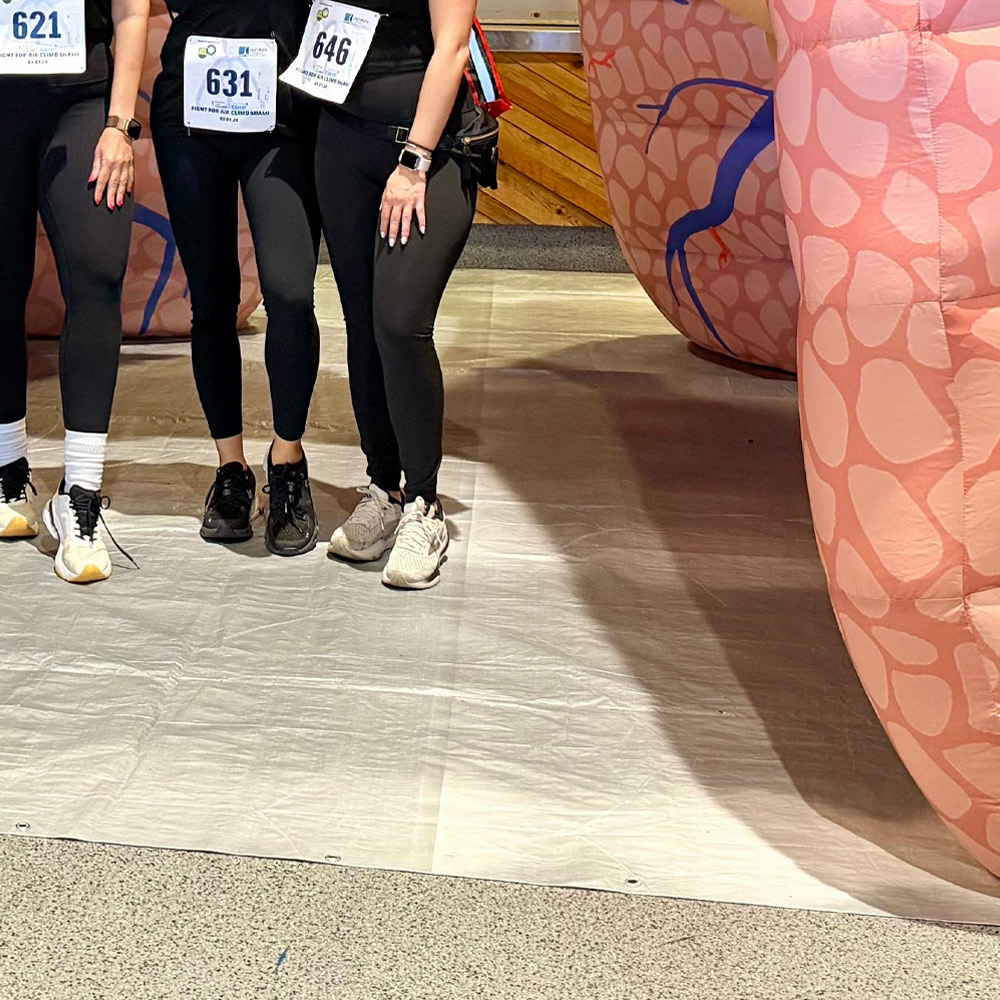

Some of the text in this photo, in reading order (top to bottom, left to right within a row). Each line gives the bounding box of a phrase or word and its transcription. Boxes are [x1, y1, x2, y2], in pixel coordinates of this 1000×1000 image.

[12, 11, 62, 40] 621
[312, 31, 352, 66] 646
[206, 68, 253, 97] 631
